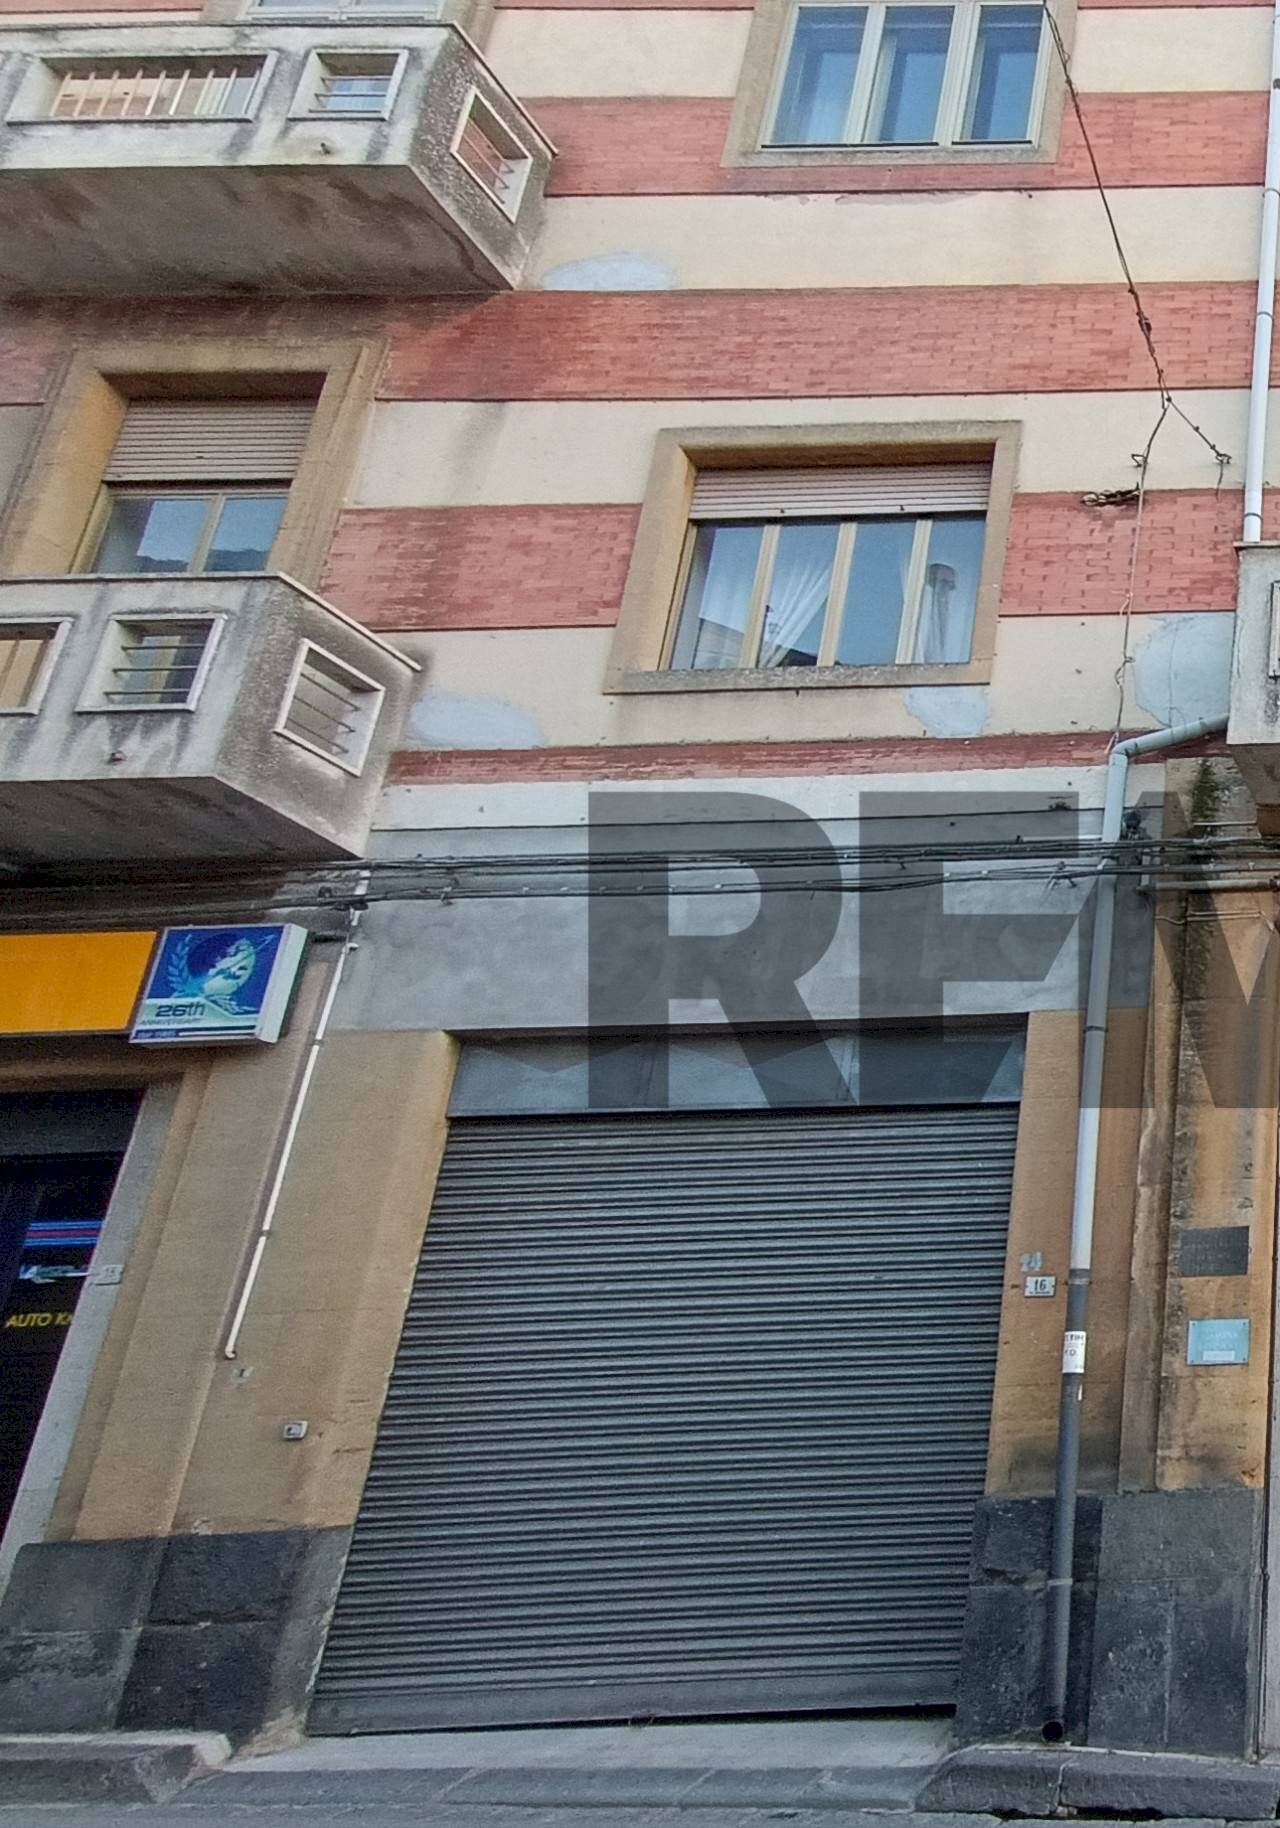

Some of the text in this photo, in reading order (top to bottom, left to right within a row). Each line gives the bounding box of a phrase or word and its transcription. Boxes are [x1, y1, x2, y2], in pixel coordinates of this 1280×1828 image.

[155, 1002, 206, 1018] 26th
[1033, 1279, 1047, 1291] 16
[5, 1312, 53, 1328] AUTO
